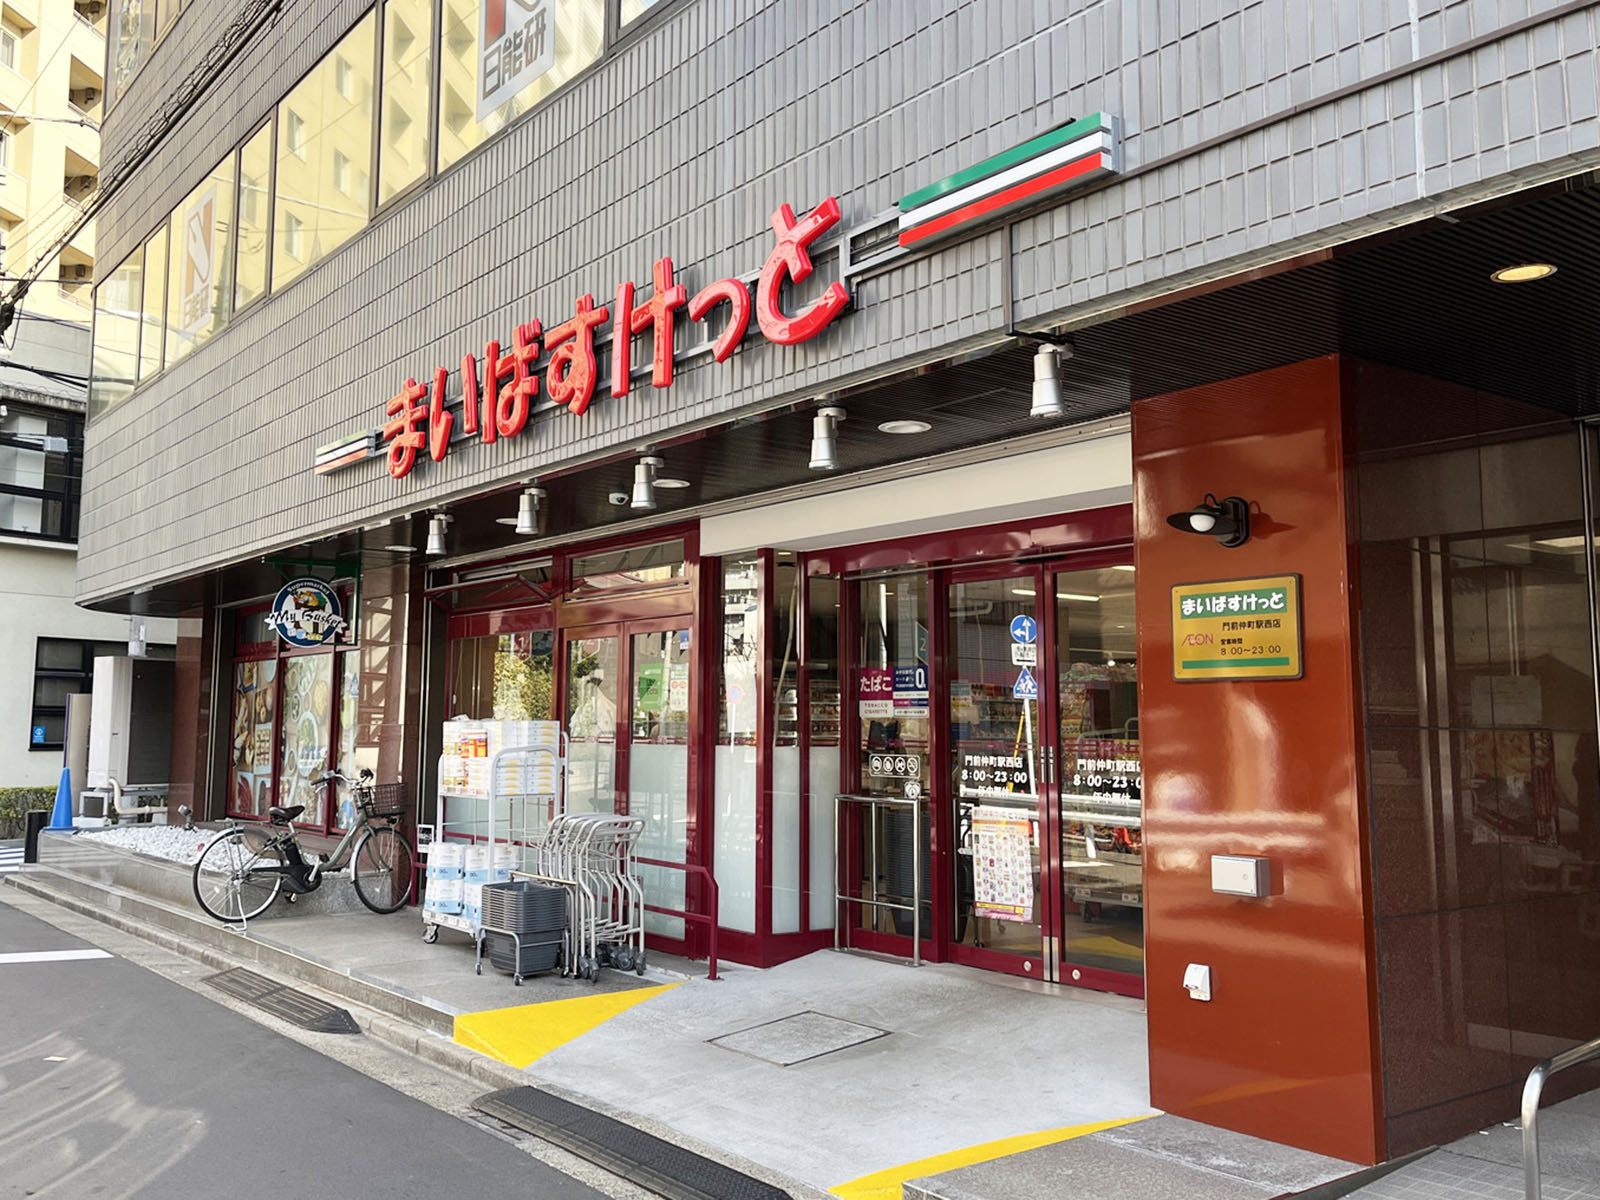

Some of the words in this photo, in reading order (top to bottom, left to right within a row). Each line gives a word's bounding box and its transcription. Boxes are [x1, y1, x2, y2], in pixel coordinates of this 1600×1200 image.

[483, 7, 546, 100] 日能研
[383, 196, 850, 479] まいばすけっと
[287, 580, 330, 596] Supermarket
[1181, 592, 1285, 616] まいばすけっと
[269, 609, 296, 625] My
[301, 609, 342, 628] Basket
[1222, 619, 1281, 631] 門前仲町駅西店
[860, 674, 892, 692] たばこ
[965, 755, 1024, 769] 門前仲町駅西店
